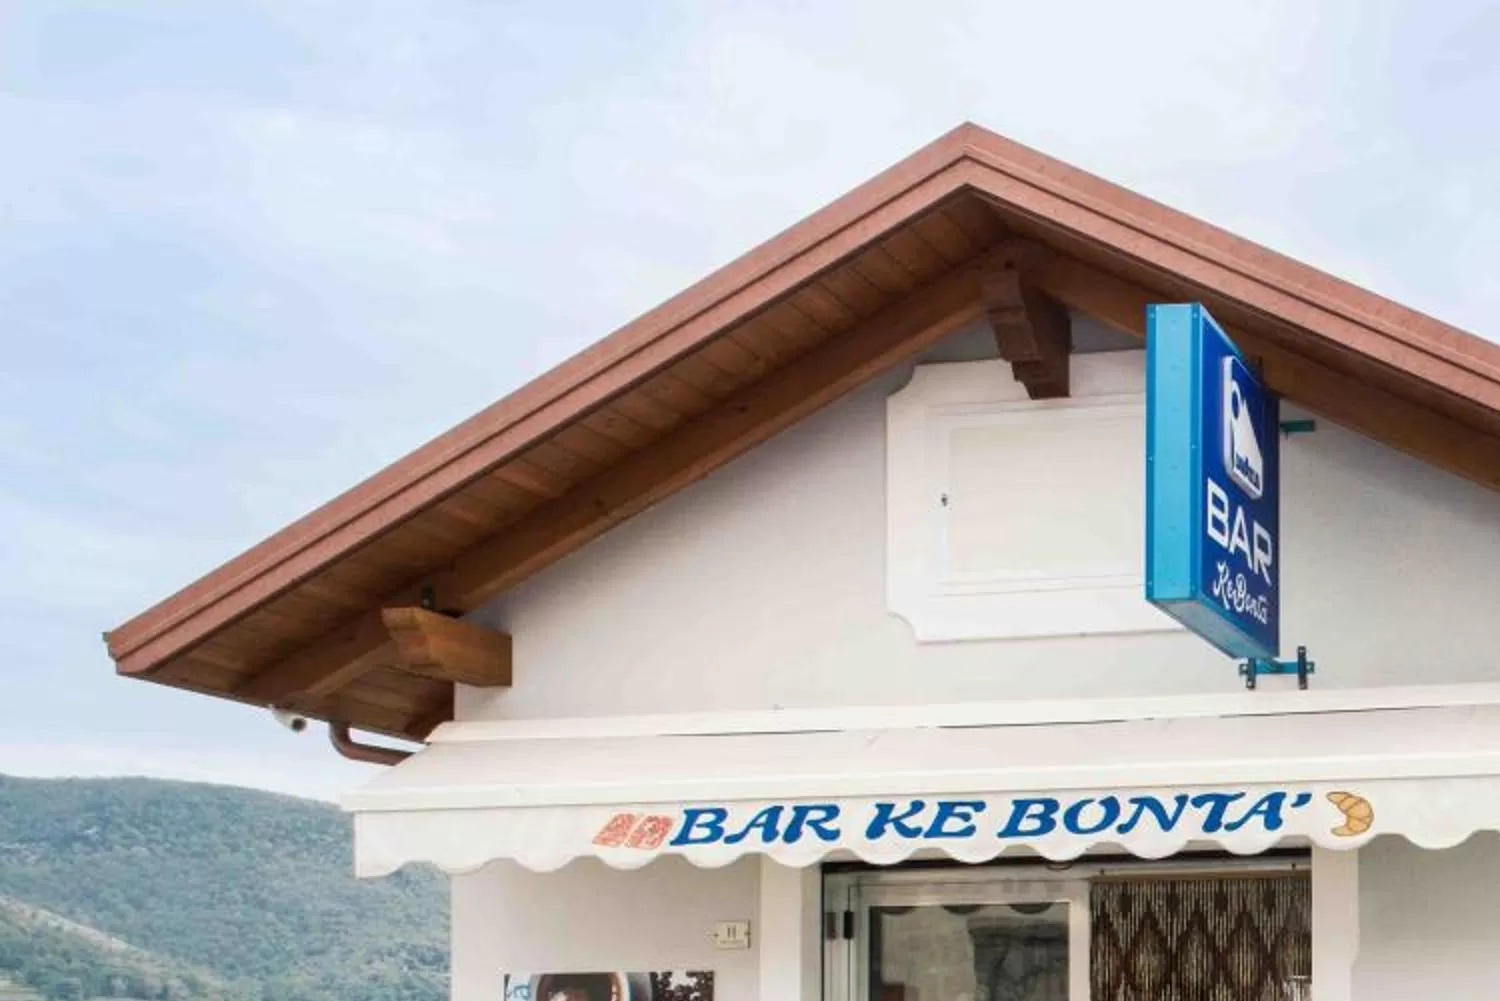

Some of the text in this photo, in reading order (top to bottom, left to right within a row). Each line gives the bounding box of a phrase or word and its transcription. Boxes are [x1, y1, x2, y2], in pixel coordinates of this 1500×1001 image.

[1206, 477, 1273, 587] BAR
[671, 804, 839, 846] BAR
[864, 799, 986, 841] KE
